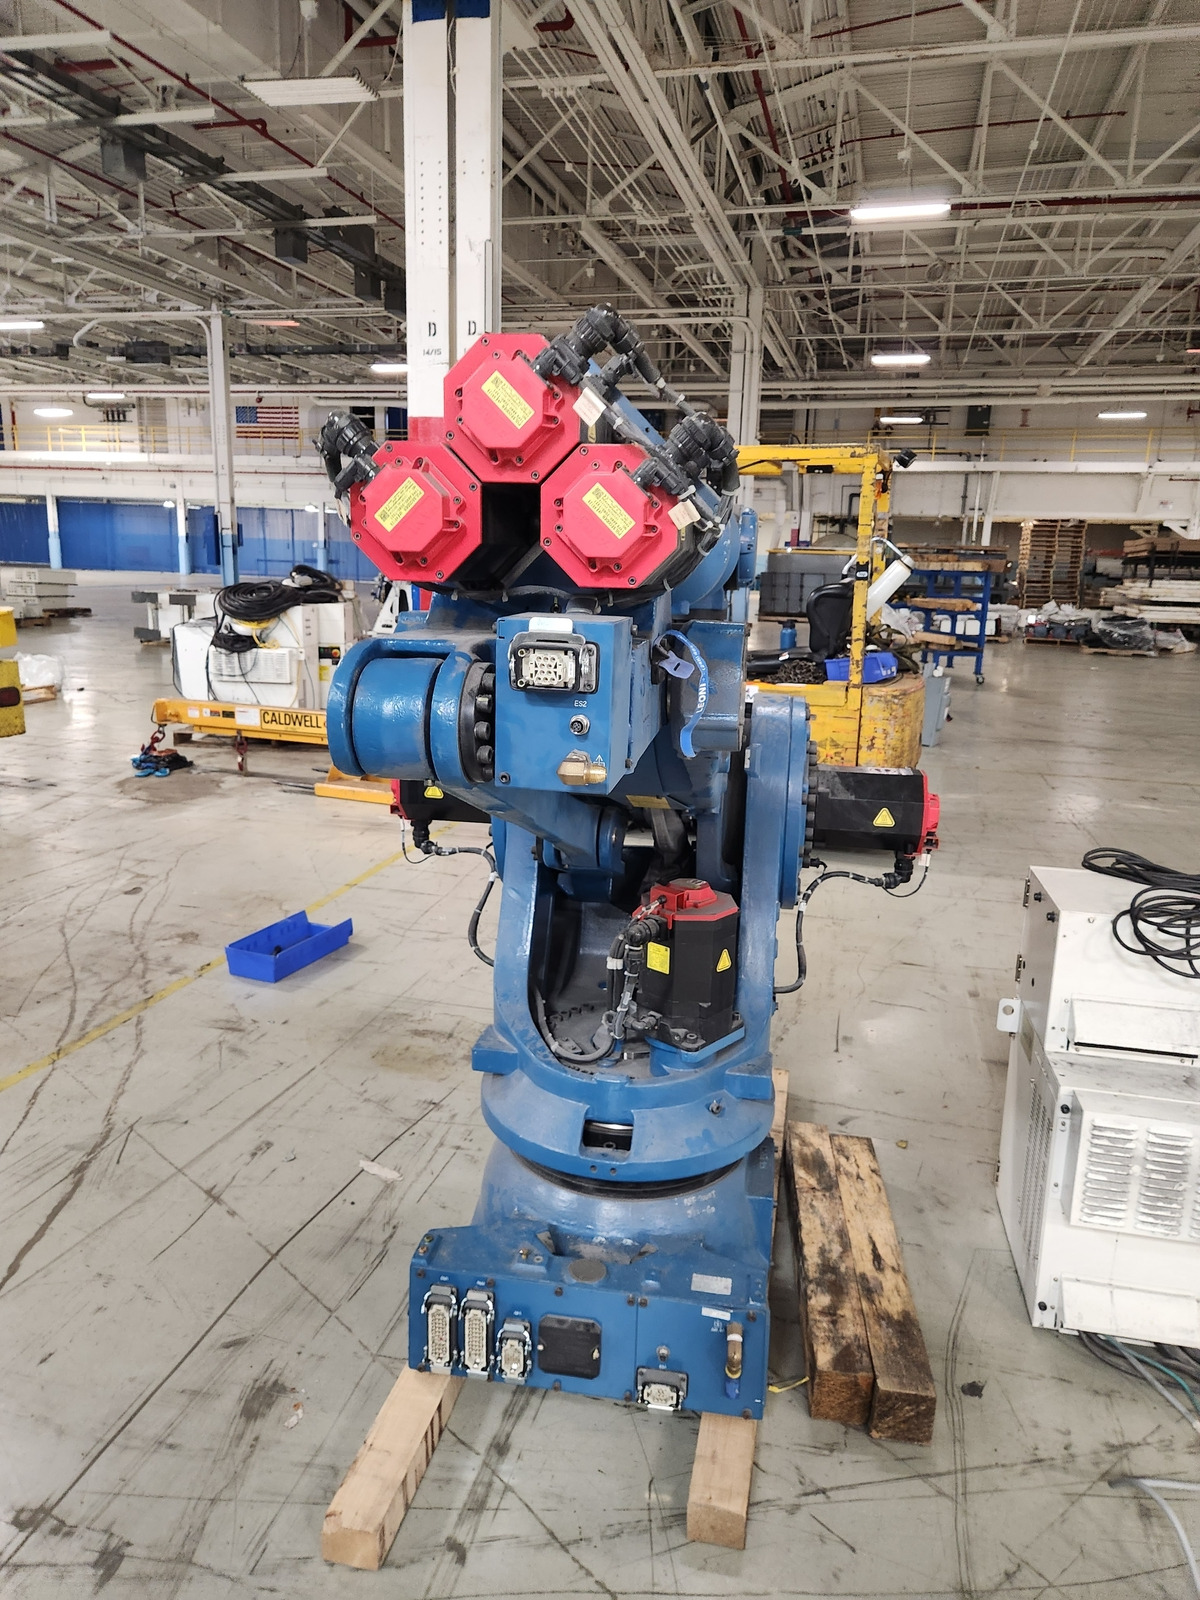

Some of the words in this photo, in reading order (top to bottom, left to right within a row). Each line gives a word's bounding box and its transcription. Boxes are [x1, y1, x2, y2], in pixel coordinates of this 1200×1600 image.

[428, 321, 437, 337] D
[468, 320, 477, 336] D
[422, 348, 442, 356] 14/15
[574, 699, 588, 708] ES2
[696, 682, 707, 714] LEONI
[262, 711, 322, 729] CALDWELL
